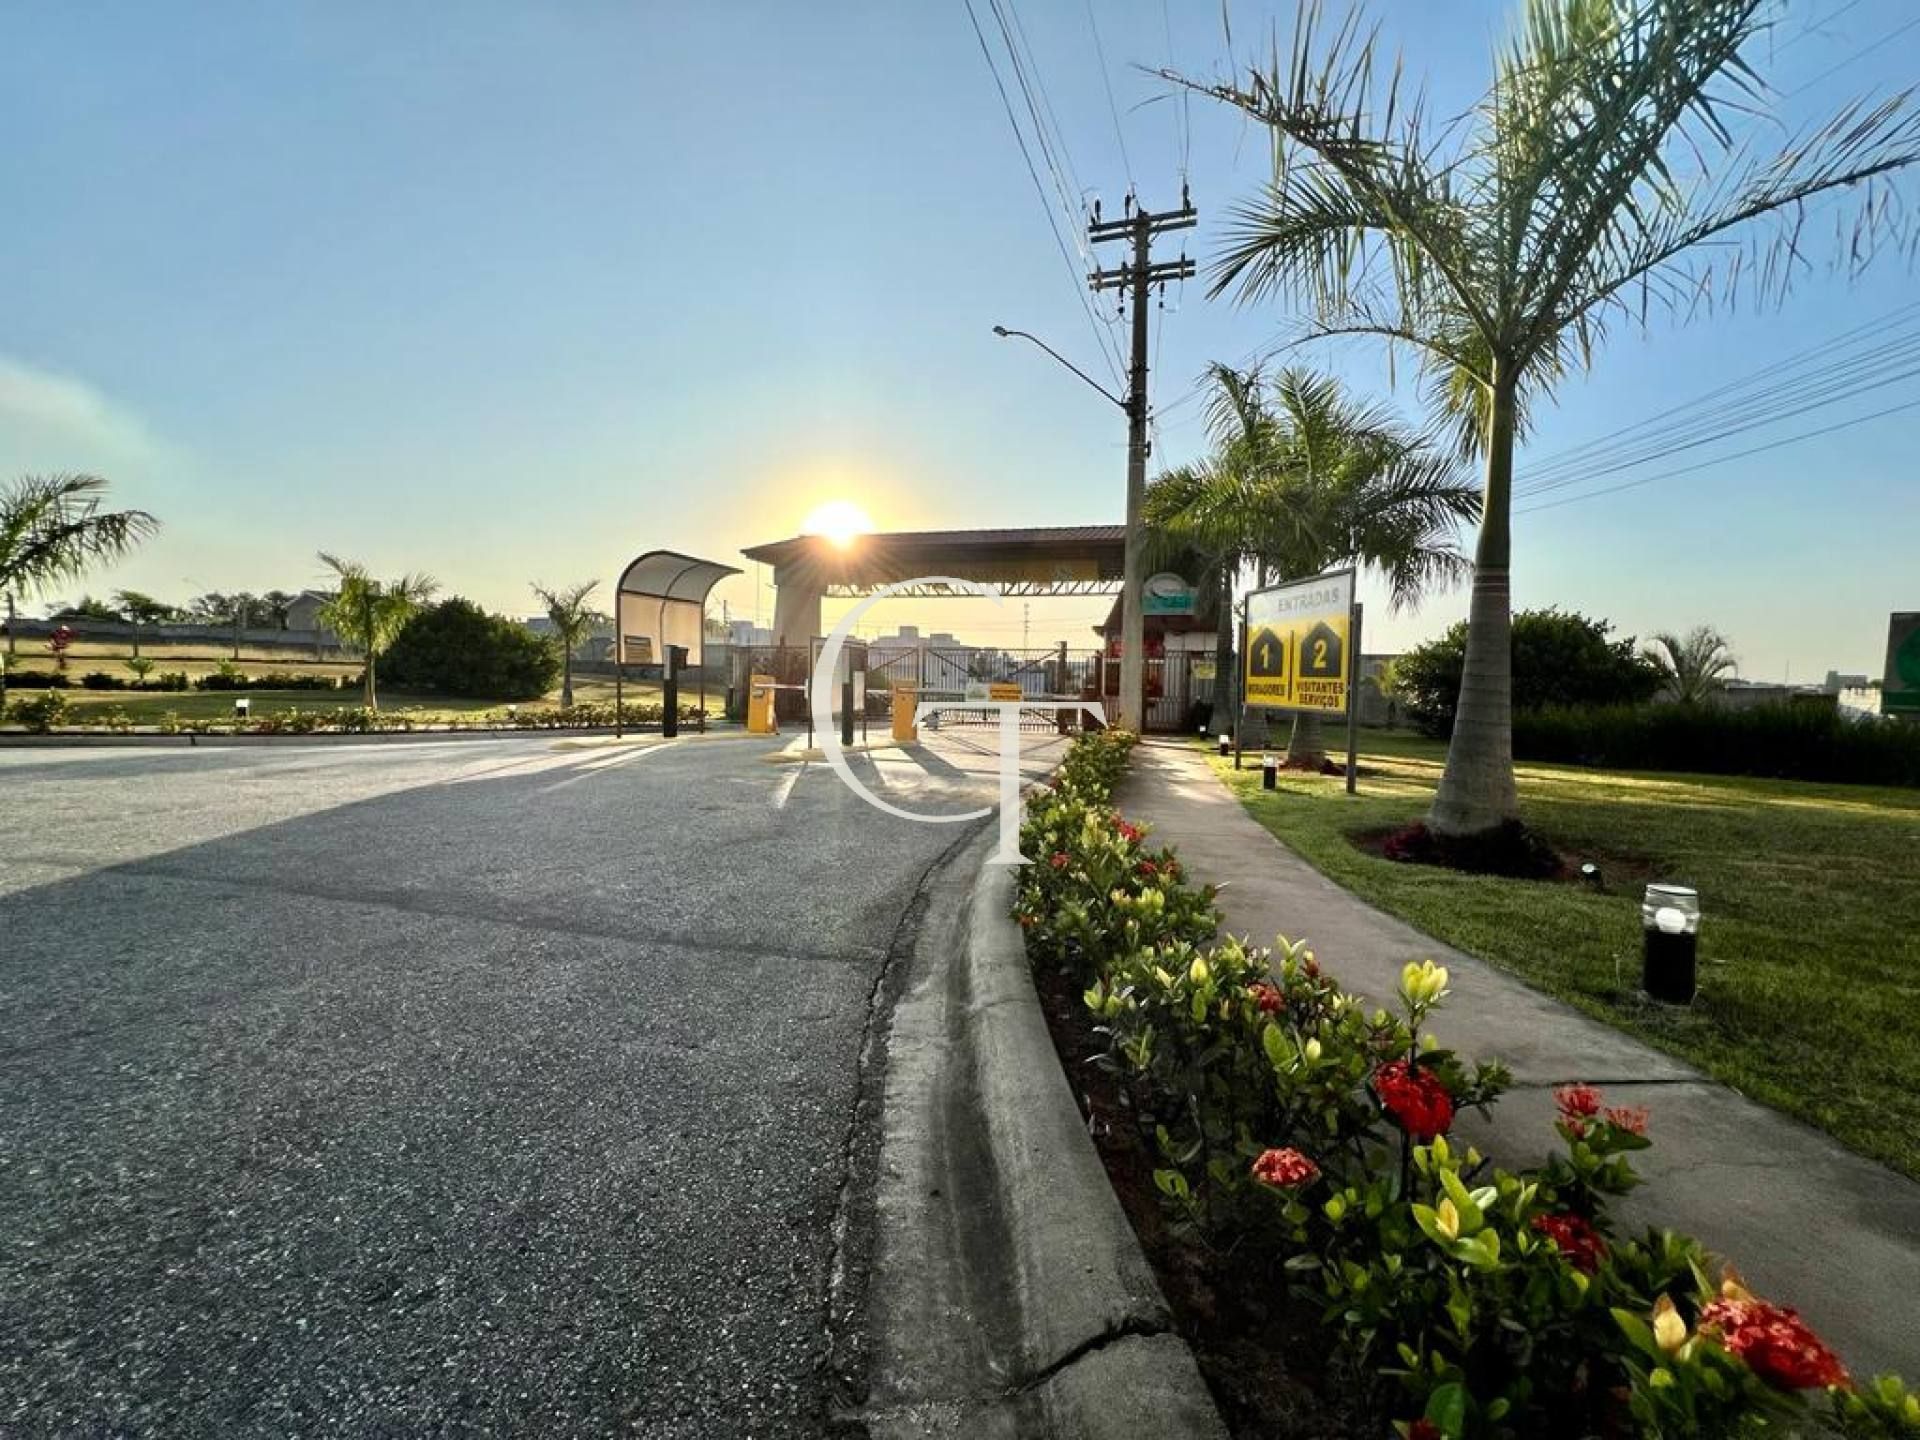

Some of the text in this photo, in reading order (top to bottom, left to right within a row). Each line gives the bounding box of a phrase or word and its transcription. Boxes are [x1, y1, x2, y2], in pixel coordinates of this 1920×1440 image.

[1277, 587, 1339, 612] ENTRADAS
[1260, 644, 1269, 669] 1
[1313, 640, 1327, 668] 2
[1297, 682, 1344, 694] VISITANTES
[1299, 694, 1339, 709] SERVIÇOS
